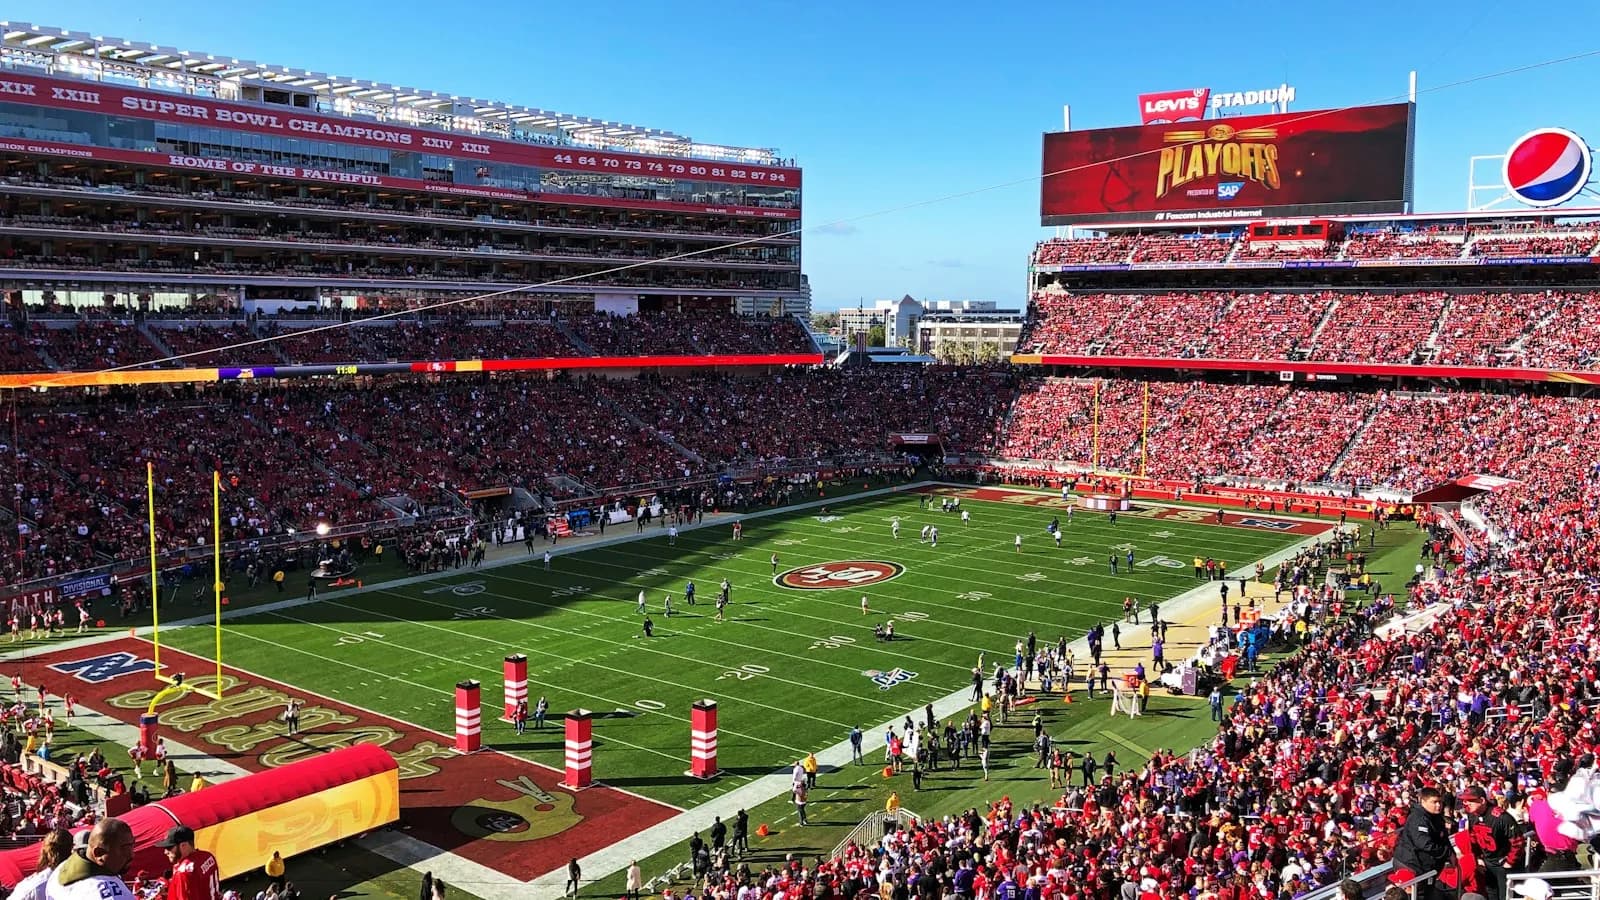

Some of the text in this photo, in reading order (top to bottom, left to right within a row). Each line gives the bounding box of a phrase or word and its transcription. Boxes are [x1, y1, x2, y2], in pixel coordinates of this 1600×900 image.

[52, 87, 100, 104] XXIII
[1212, 86, 1296, 108] STADIUM
[122, 96, 491, 154] SUPER BOWL CHAMPIONS XXIV XXIX
[28, 145, 93, 157] CHAMPIONS
[169, 155, 382, 185] HOME OF THE FAITHFUL
[554, 154, 573, 164] 44
[602, 158, 619, 168] 70
[625, 160, 641, 169] 73
[647, 162, 664, 171] 74
[668, 164, 685, 173] 79
[690, 166, 706, 175] 80
[712, 168, 725, 177] 81
[751, 171, 766, 180] 87
[770, 173, 785, 182] 94
[1156, 142, 1280, 199] PLAYOFFS
[1218, 186, 1239, 196] SAP
[1166, 210, 1197, 219] Foxconn
[1198, 209, 1232, 218] Industrial
[1232, 209, 1262, 217] Internet
[63, 578, 105, 593] DIVISIONAL
[812, 635, 857, 650] 30
[722, 664, 771, 681] 20
